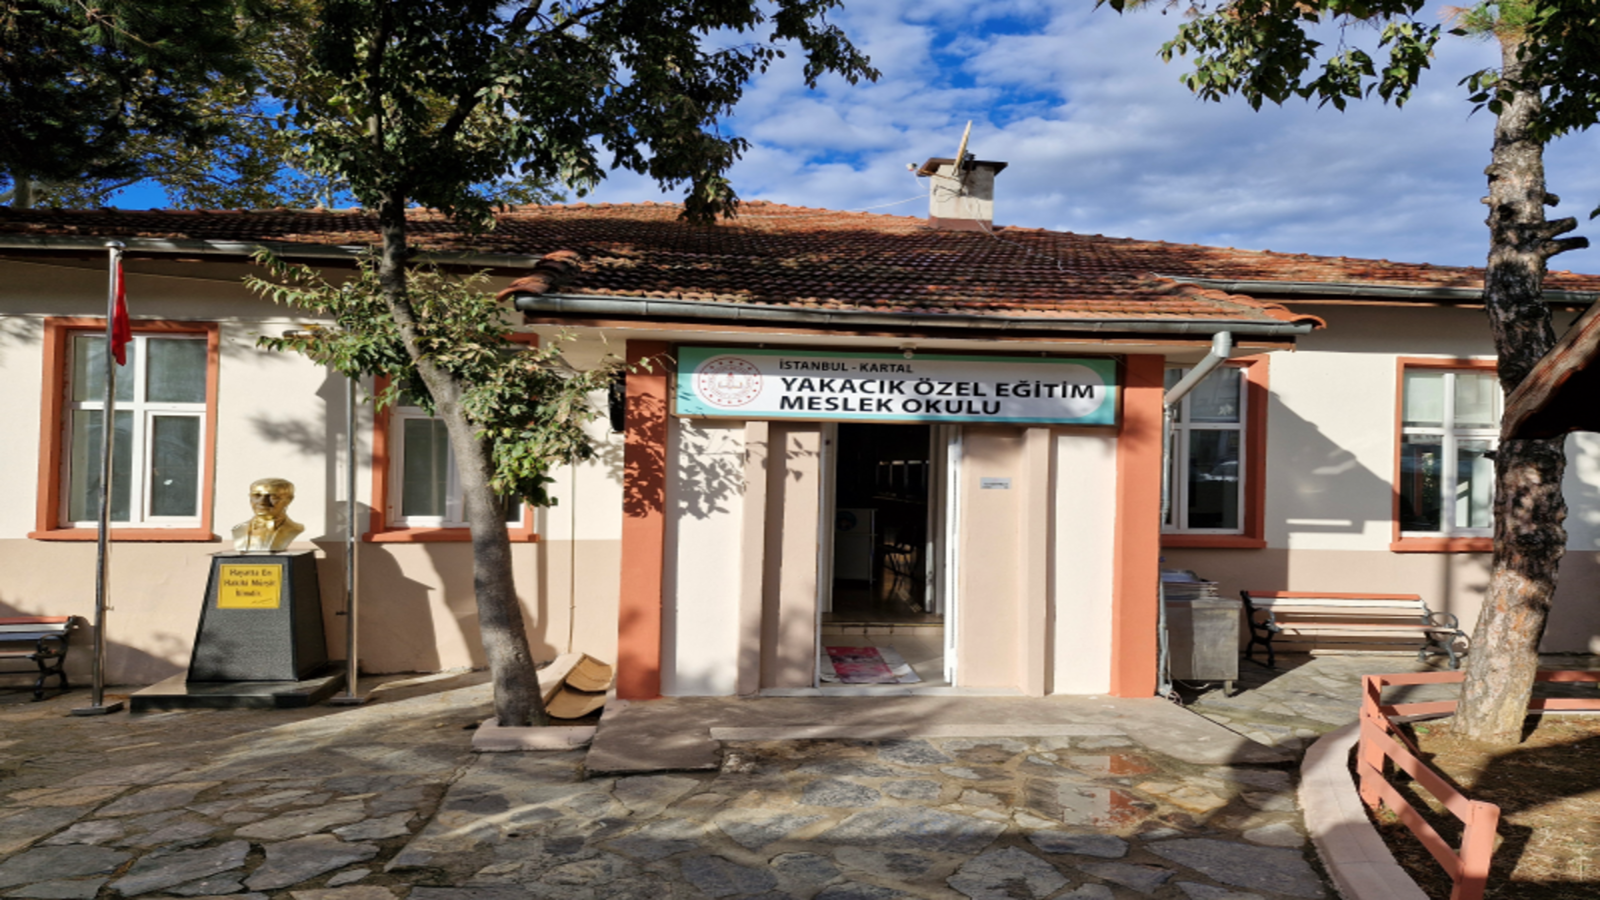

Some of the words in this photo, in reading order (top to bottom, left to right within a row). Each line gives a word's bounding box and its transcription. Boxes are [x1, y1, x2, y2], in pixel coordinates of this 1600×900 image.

[779, 360, 848, 371] İSTANBUL
[859, 362, 914, 374] KARTAL
[781, 377, 905, 395] YAKACIK
[913, 376, 987, 397] ÖZEL
[995, 379, 1095, 399] EĞİTİM
[779, 396, 893, 413] MESLEK
[901, 398, 1000, 415] OKULU
